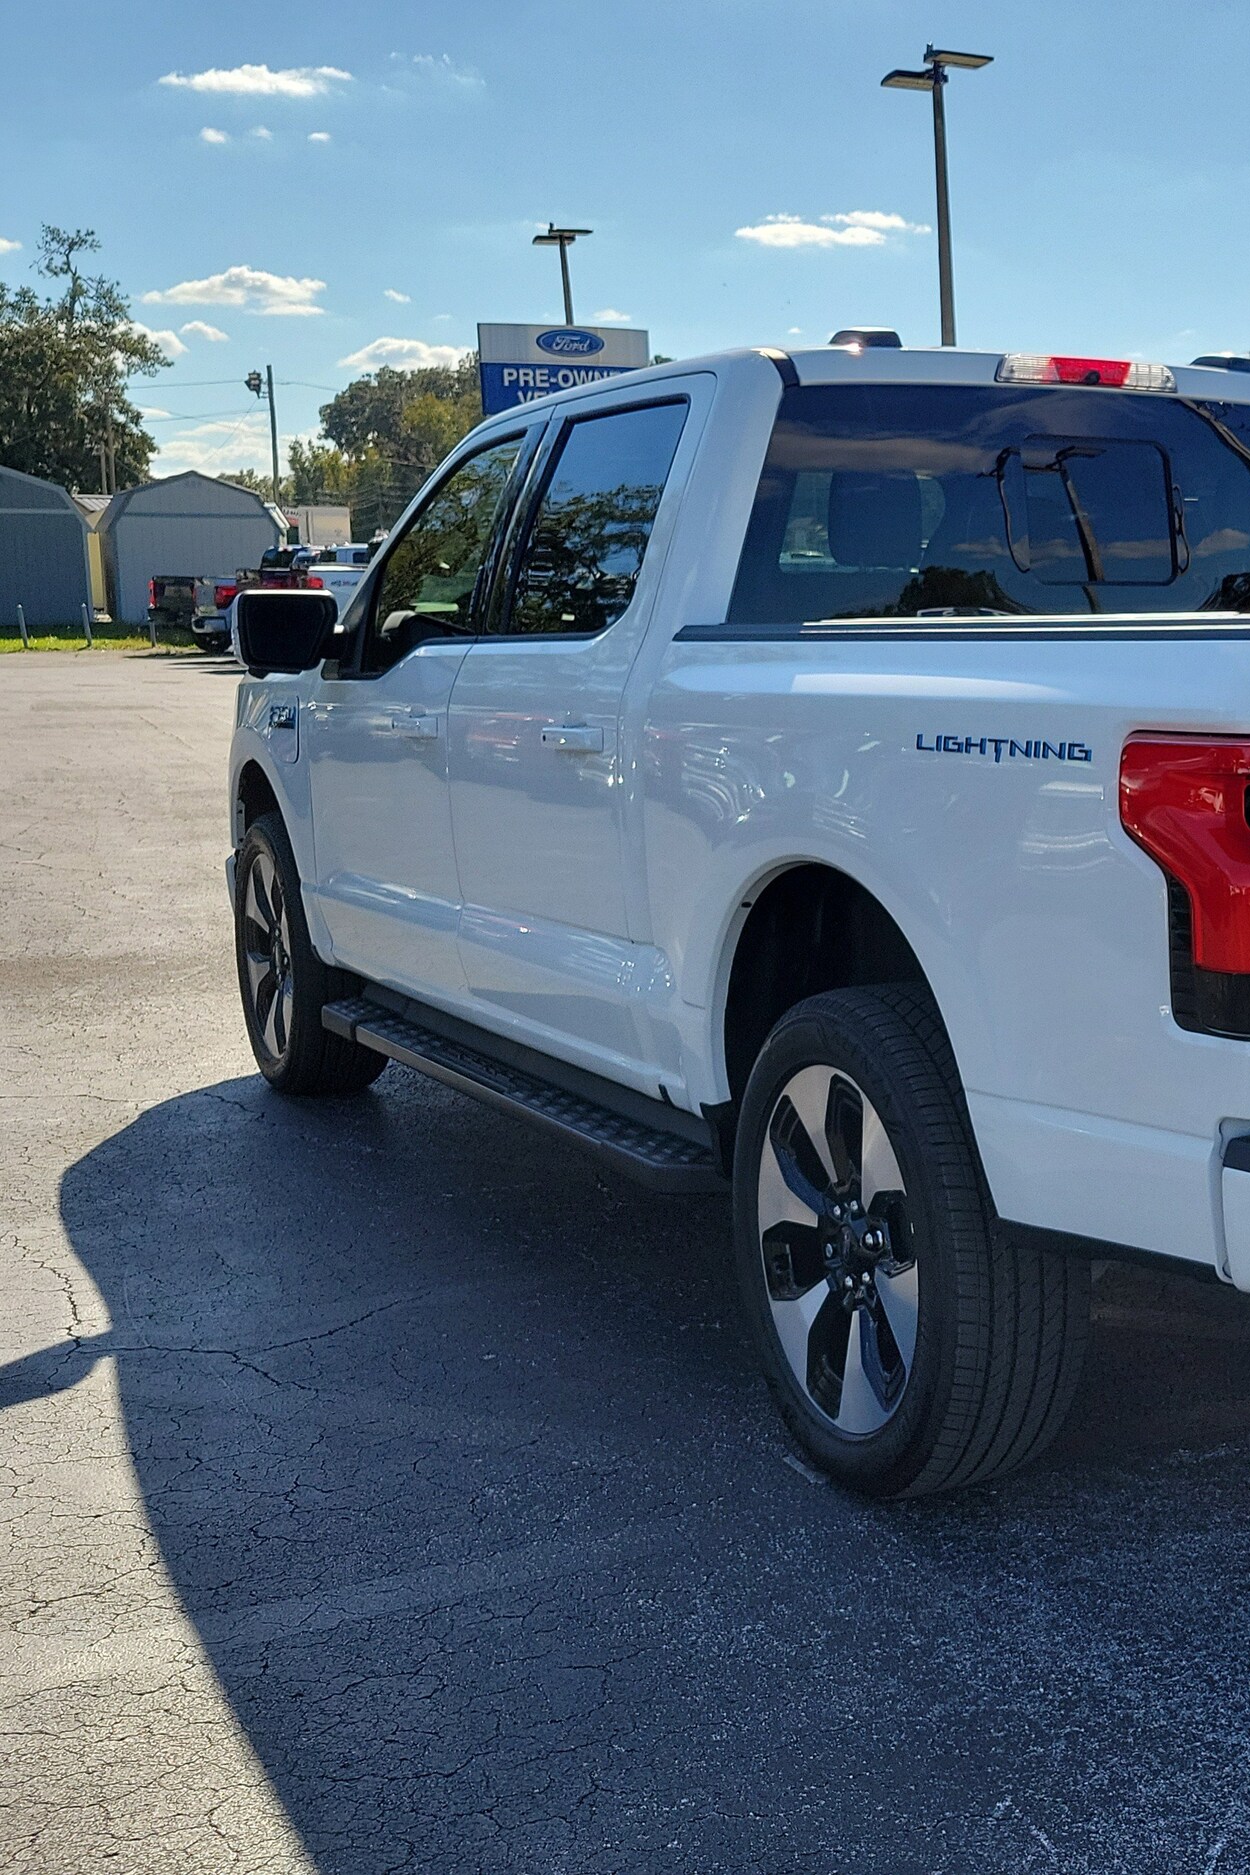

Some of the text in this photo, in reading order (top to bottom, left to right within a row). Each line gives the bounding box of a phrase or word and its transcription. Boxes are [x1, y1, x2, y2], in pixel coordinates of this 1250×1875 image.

[552, 336, 590, 352] Ford
[503, 368, 622, 387] PRE-OWN
[916, 734, 1092, 763] LIGHTNING
